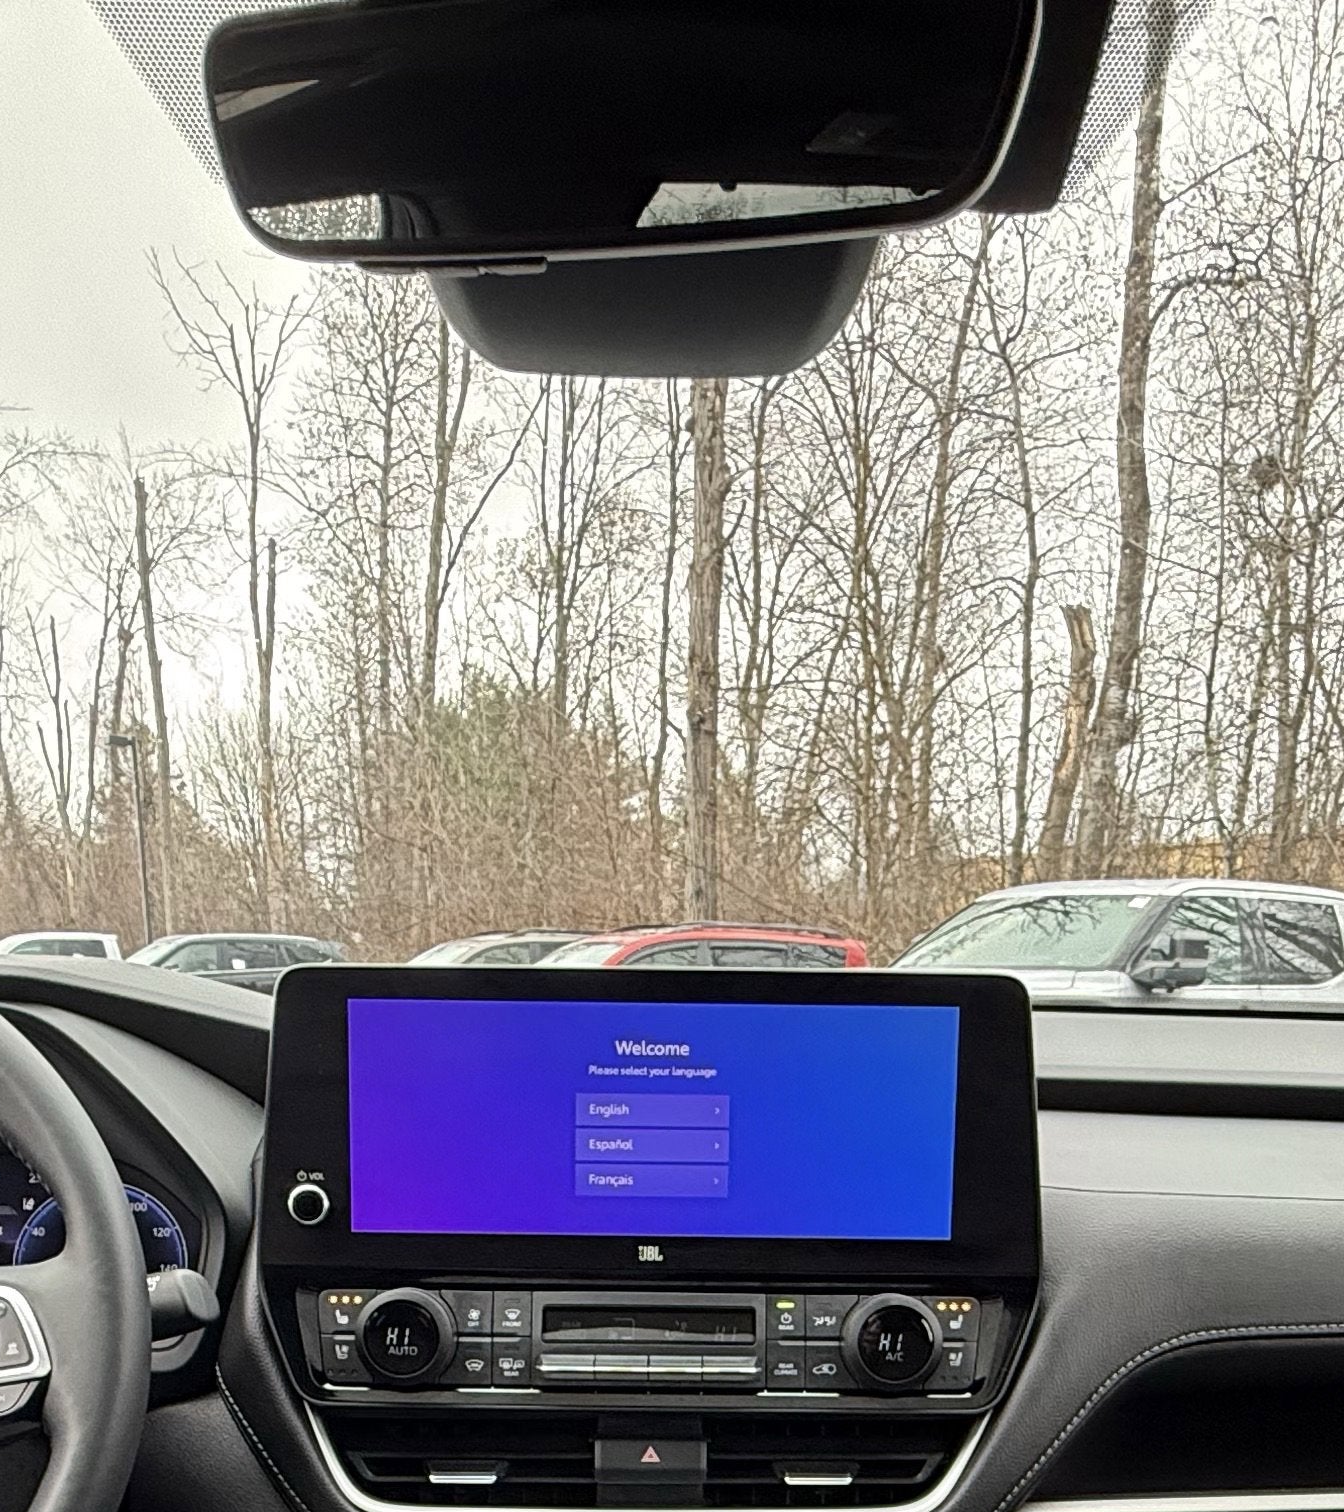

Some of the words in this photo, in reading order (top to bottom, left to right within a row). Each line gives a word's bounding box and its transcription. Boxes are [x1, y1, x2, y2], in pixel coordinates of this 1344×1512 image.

[615, 1040, 690, 1056] Welcome
[588, 1065, 619, 1075] Please
[620, 1066, 648, 1076] select
[649, 1067, 671, 1078] your
[672, 1066, 717, 1078] language
[589, 1104, 629, 1117] English
[589, 1138, 633, 1151] Español
[308, 1172, 325, 1181] VOL
[588, 1174, 634, 1187] Français
[32, 1228, 45, 1237] 40
[152, 1227, 171, 1238] 120
[638, 1246, 664, 1262] JBL
[388, 1345, 419, 1356] AUTO
[885, 1351, 905, 1362] A/C
